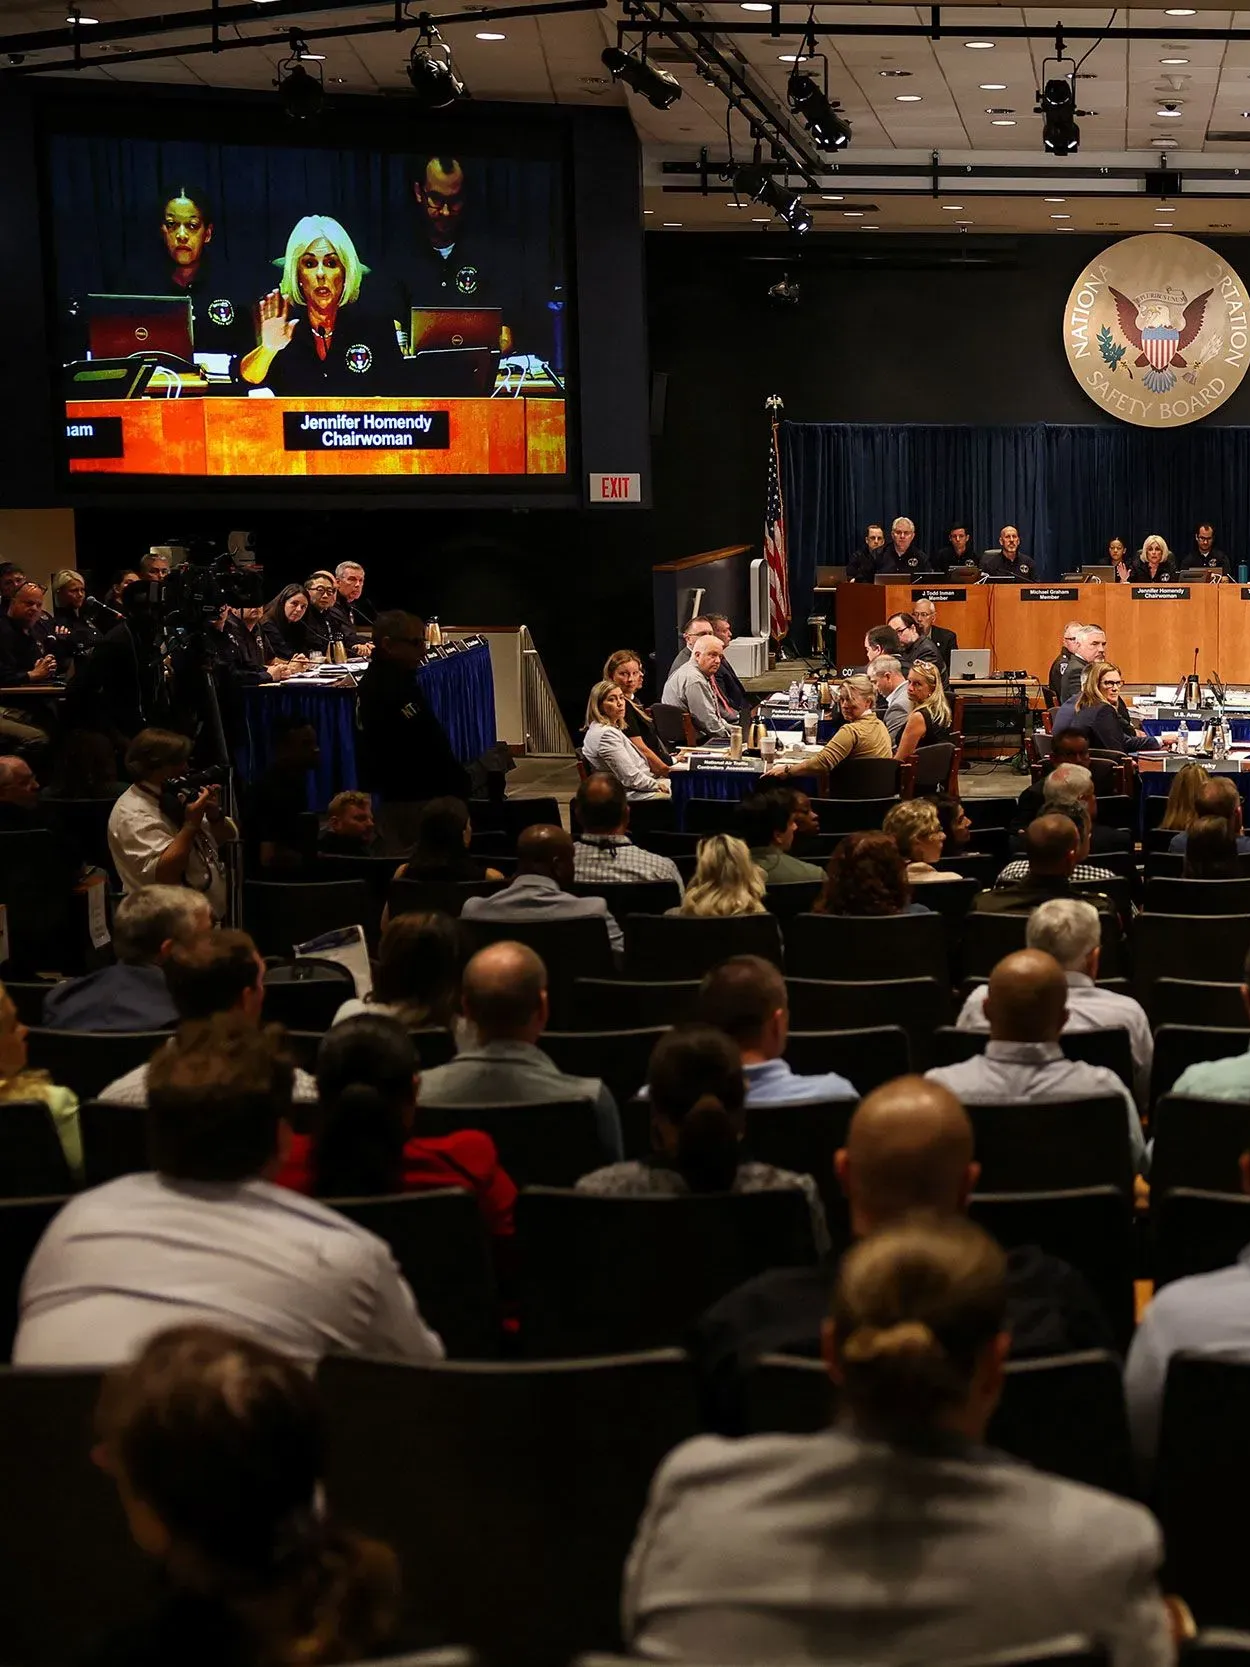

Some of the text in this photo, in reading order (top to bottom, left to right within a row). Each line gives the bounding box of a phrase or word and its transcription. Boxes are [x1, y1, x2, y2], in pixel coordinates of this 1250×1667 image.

[1072, 264, 1111, 359] NATIONA
[1086, 371, 1226, 420] SAFETY BOARD
[300, 414, 432, 432] Jennifer Homendy
[322, 431, 413, 446] Chairwoman
[602, 477, 629, 498] EXIT
[1159, 587, 1185, 595] Homendy
[1186, 711, 1202, 719] Army
